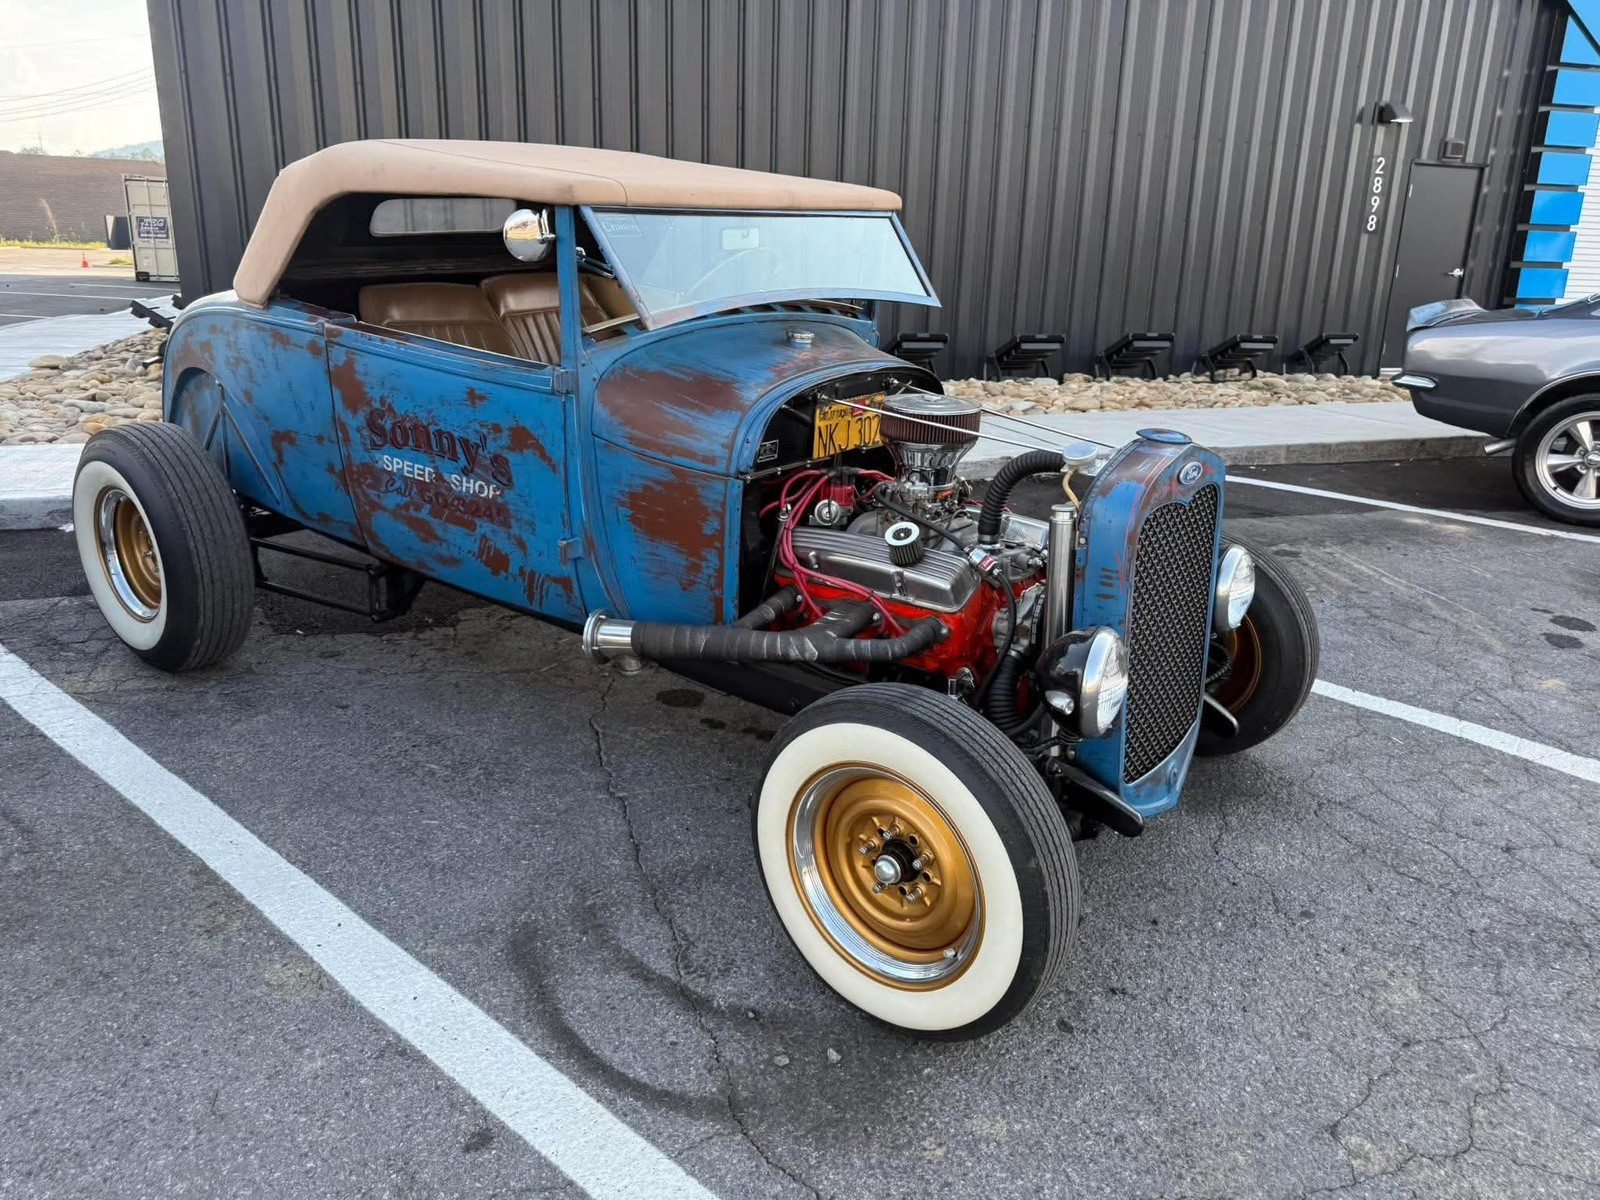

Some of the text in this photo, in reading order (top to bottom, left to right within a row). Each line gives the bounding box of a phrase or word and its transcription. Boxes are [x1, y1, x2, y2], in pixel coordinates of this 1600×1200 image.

[1366, 157, 1386, 232] 2898
[365, 409, 514, 489] Sonny's
[817, 420, 851, 458] NKJ
[854, 414, 881, 447] 302
[383, 455, 502, 500] SPEED SHOP
